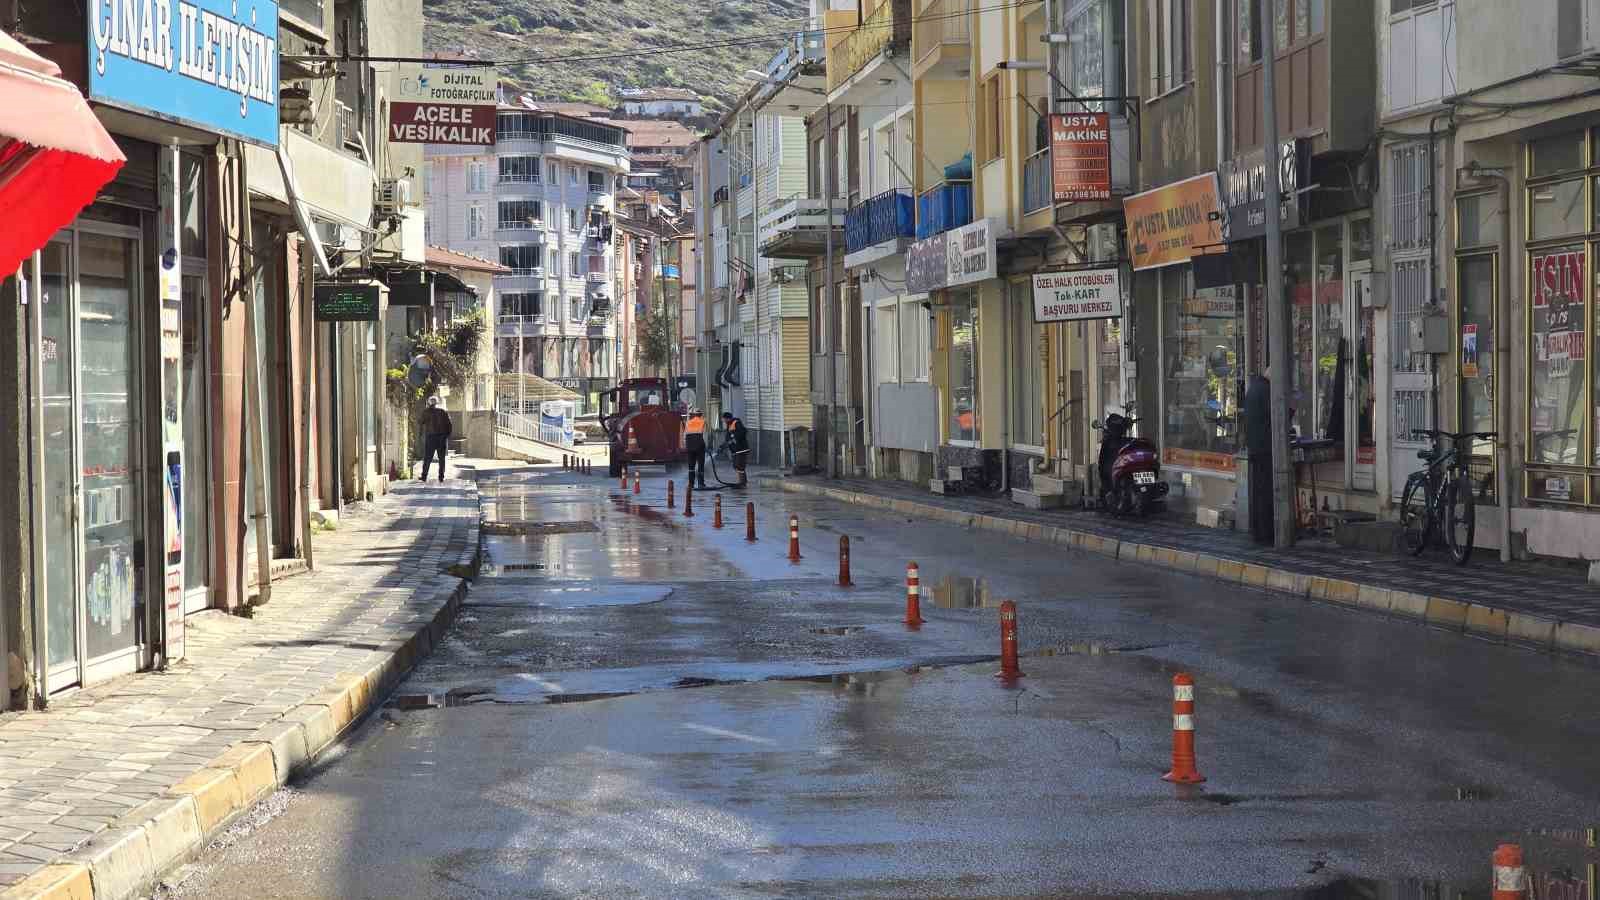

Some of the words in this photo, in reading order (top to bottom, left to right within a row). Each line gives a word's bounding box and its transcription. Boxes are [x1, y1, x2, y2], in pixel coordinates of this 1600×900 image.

[92, 0, 173, 76] ÇINAR
[444, 73, 483, 86] DİJİTAL
[431, 87, 495, 101] FOTOĞRAFÇILIK
[414, 106, 473, 124] ACELE
[1062, 116, 1098, 127] USTA
[392, 121, 491, 143] VESİKALIK
[1055, 128, 1107, 141] MAKİNE
[1037, 277, 1053, 288] ÖZEL
[1055, 276, 1072, 288] HALK
[1043, 303, 1079, 317] BAŞVURU
